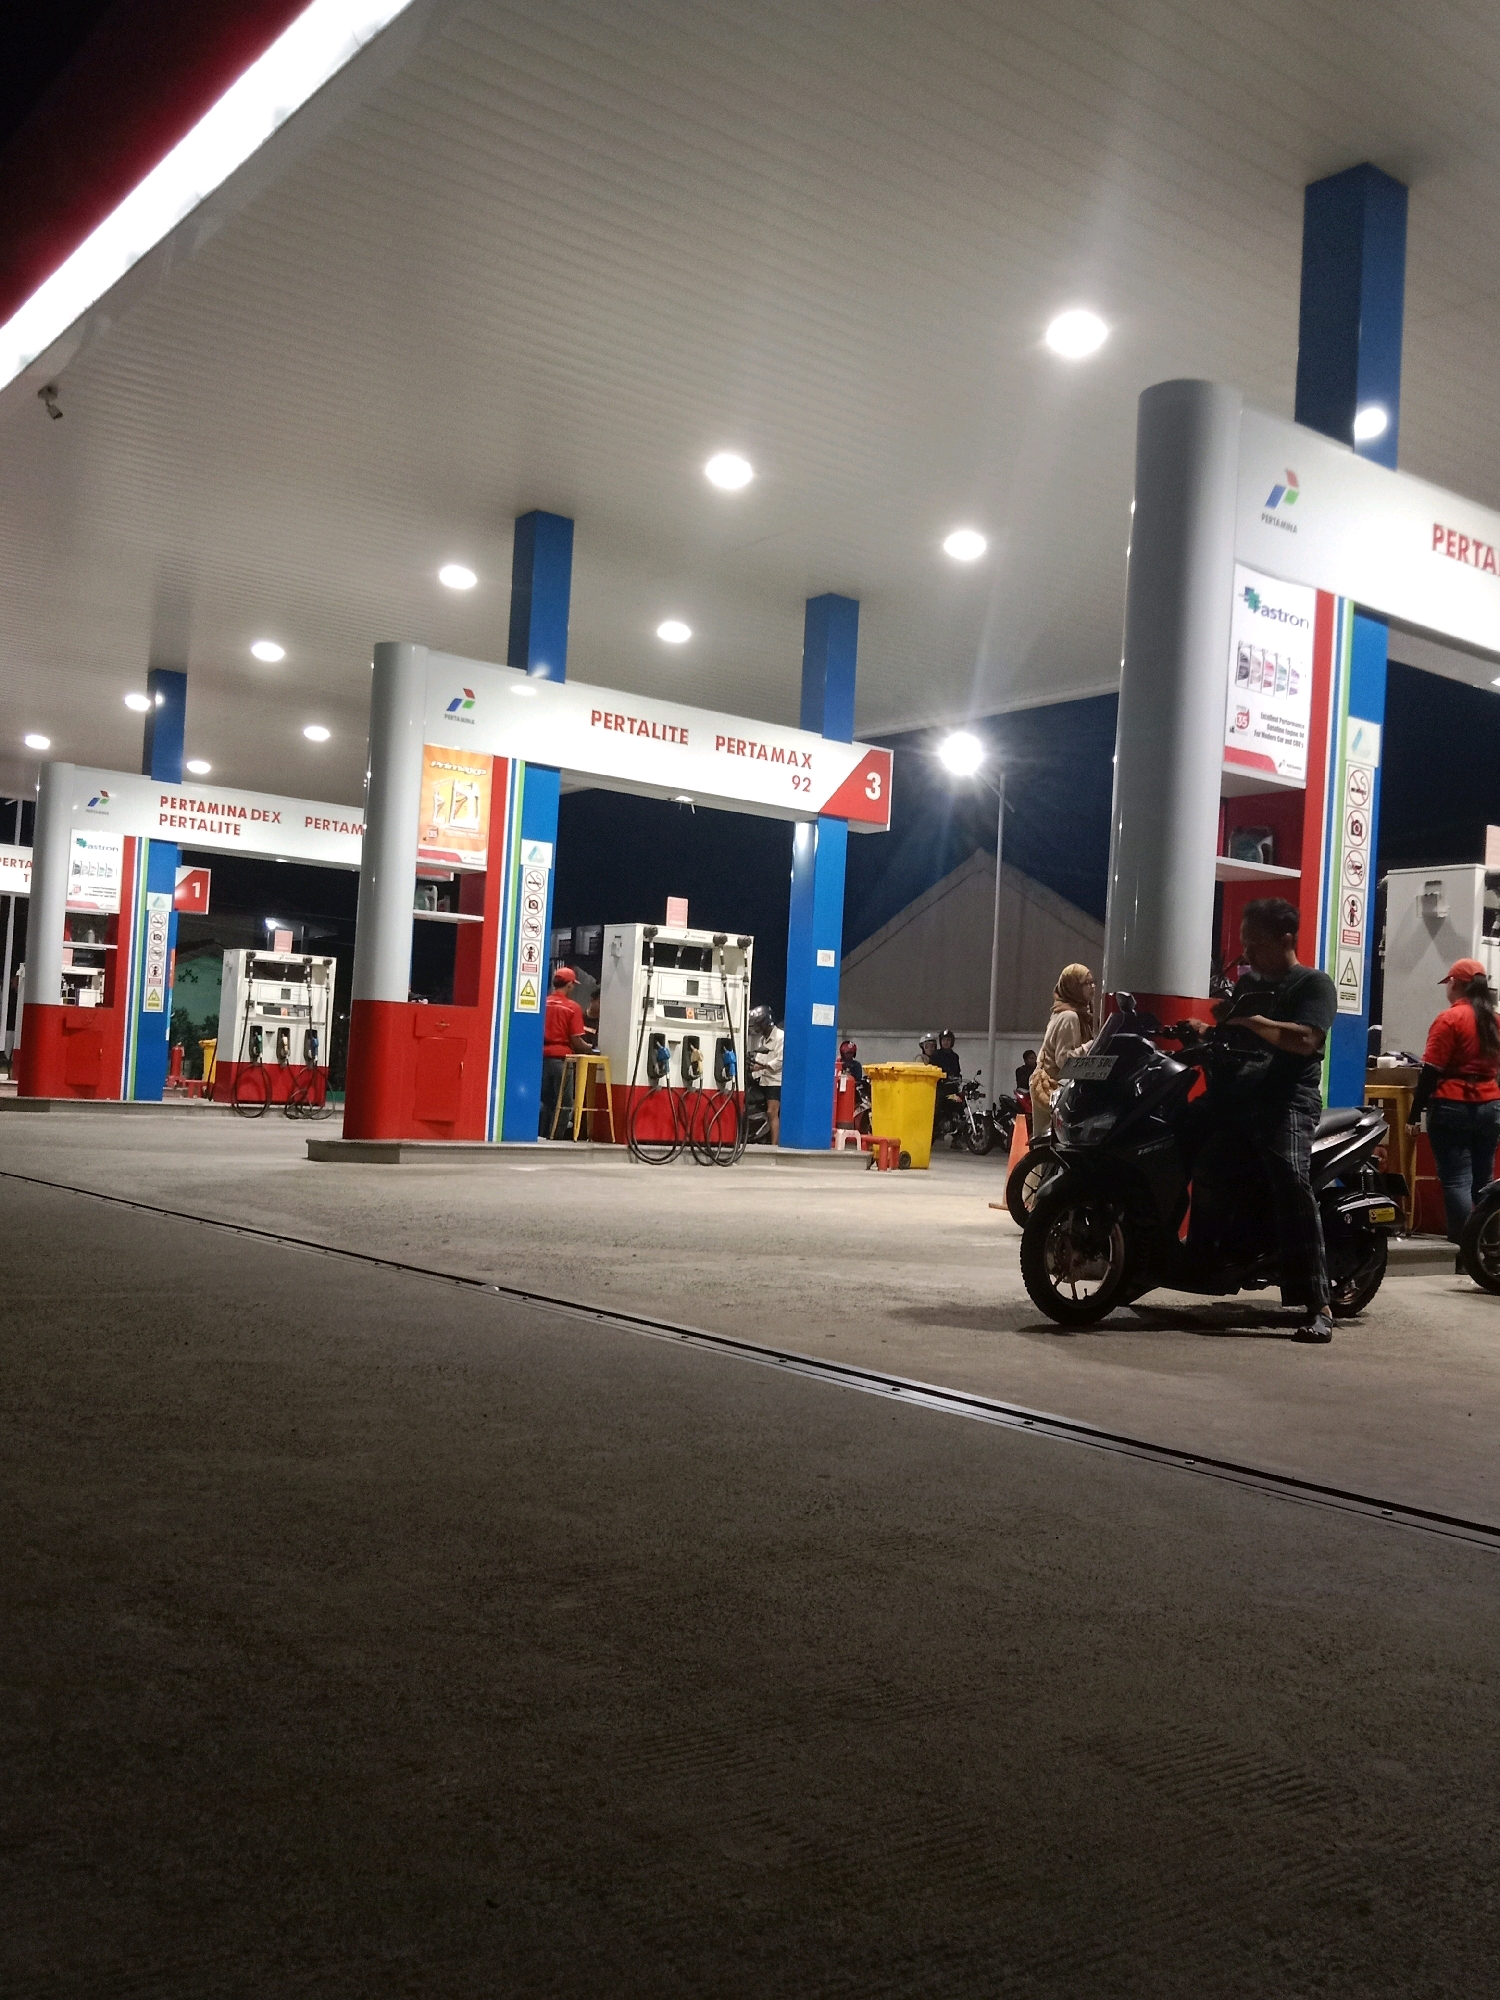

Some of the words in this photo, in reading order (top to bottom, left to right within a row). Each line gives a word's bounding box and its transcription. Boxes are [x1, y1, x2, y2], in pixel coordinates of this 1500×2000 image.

[1432, 522, 1500, 577] PERTA
[1261, 605, 1309, 629] astron
[590, 709, 689, 745] PERTALITE
[715, 735, 813, 770] PERTAMAX
[791, 774, 812, 793] 92
[864, 771, 881, 800] 3
[160, 795, 247, 819] PERTAMINA
[250, 808, 282, 824] DEX
[159, 813, 241, 836] PERTALITE
[0, 857, 34, 869] ERTA
[191, 881, 201, 898] 1
